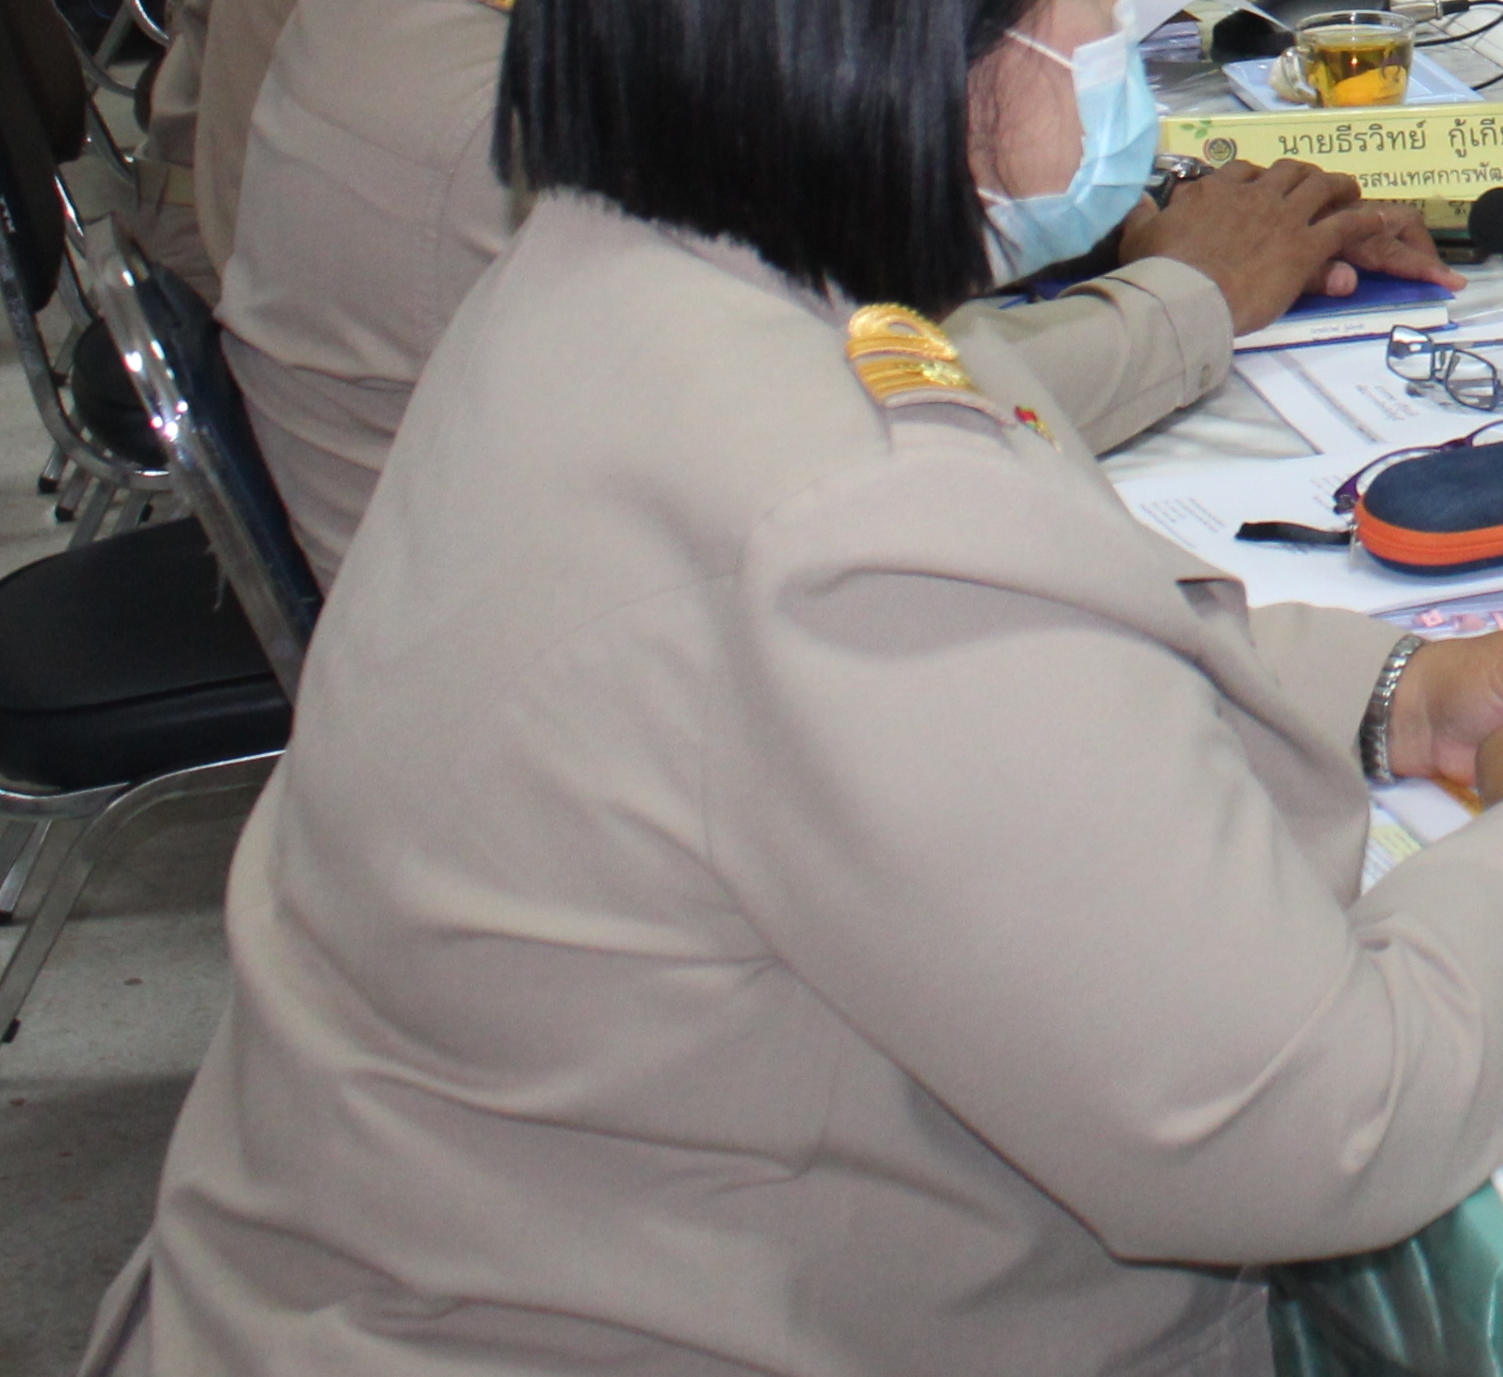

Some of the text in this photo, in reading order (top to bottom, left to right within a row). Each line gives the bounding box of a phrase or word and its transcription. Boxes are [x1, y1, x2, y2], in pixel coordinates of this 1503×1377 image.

[1278, 119, 1428, 156] นายธีรวิทย์
